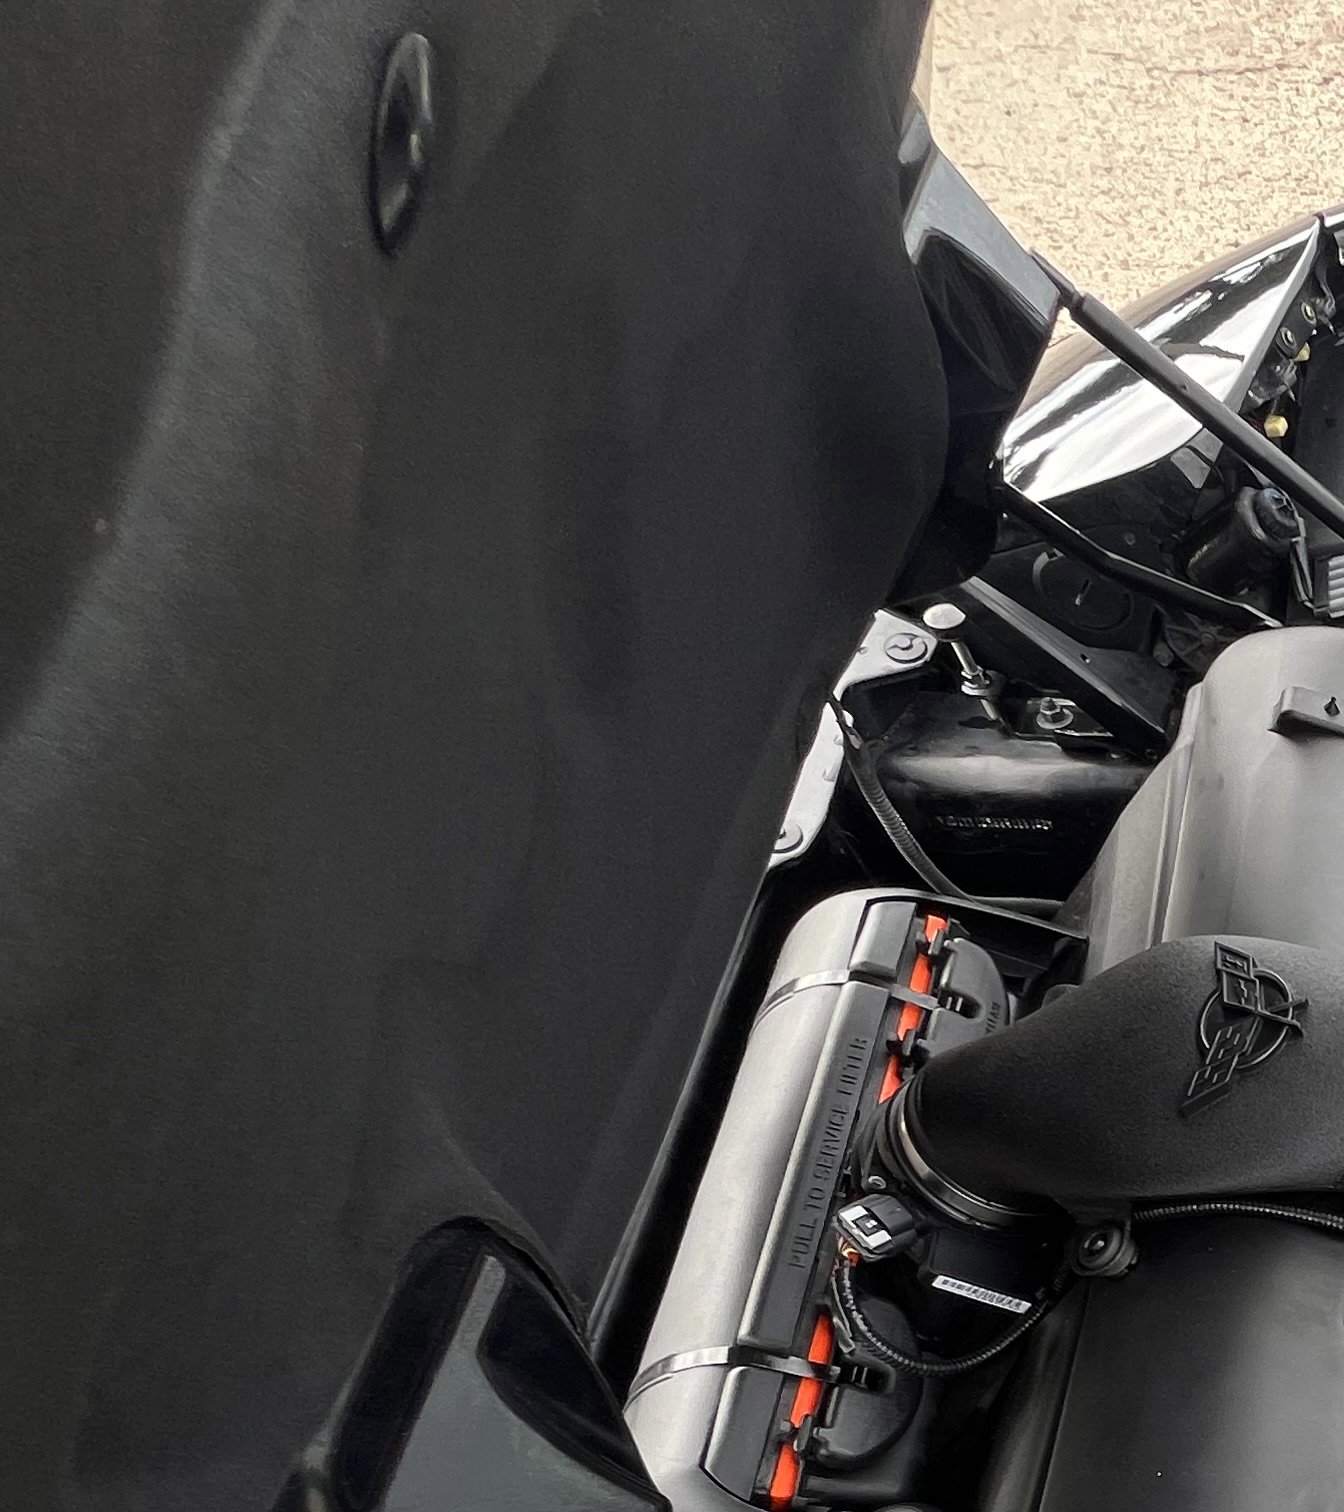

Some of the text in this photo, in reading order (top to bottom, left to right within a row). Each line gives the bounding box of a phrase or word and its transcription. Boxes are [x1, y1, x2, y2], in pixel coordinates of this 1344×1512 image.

[813, 1103, 848, 1181] SERVICE
[803, 1187, 826, 1210] TO
[787, 1217, 818, 1269] PULL
